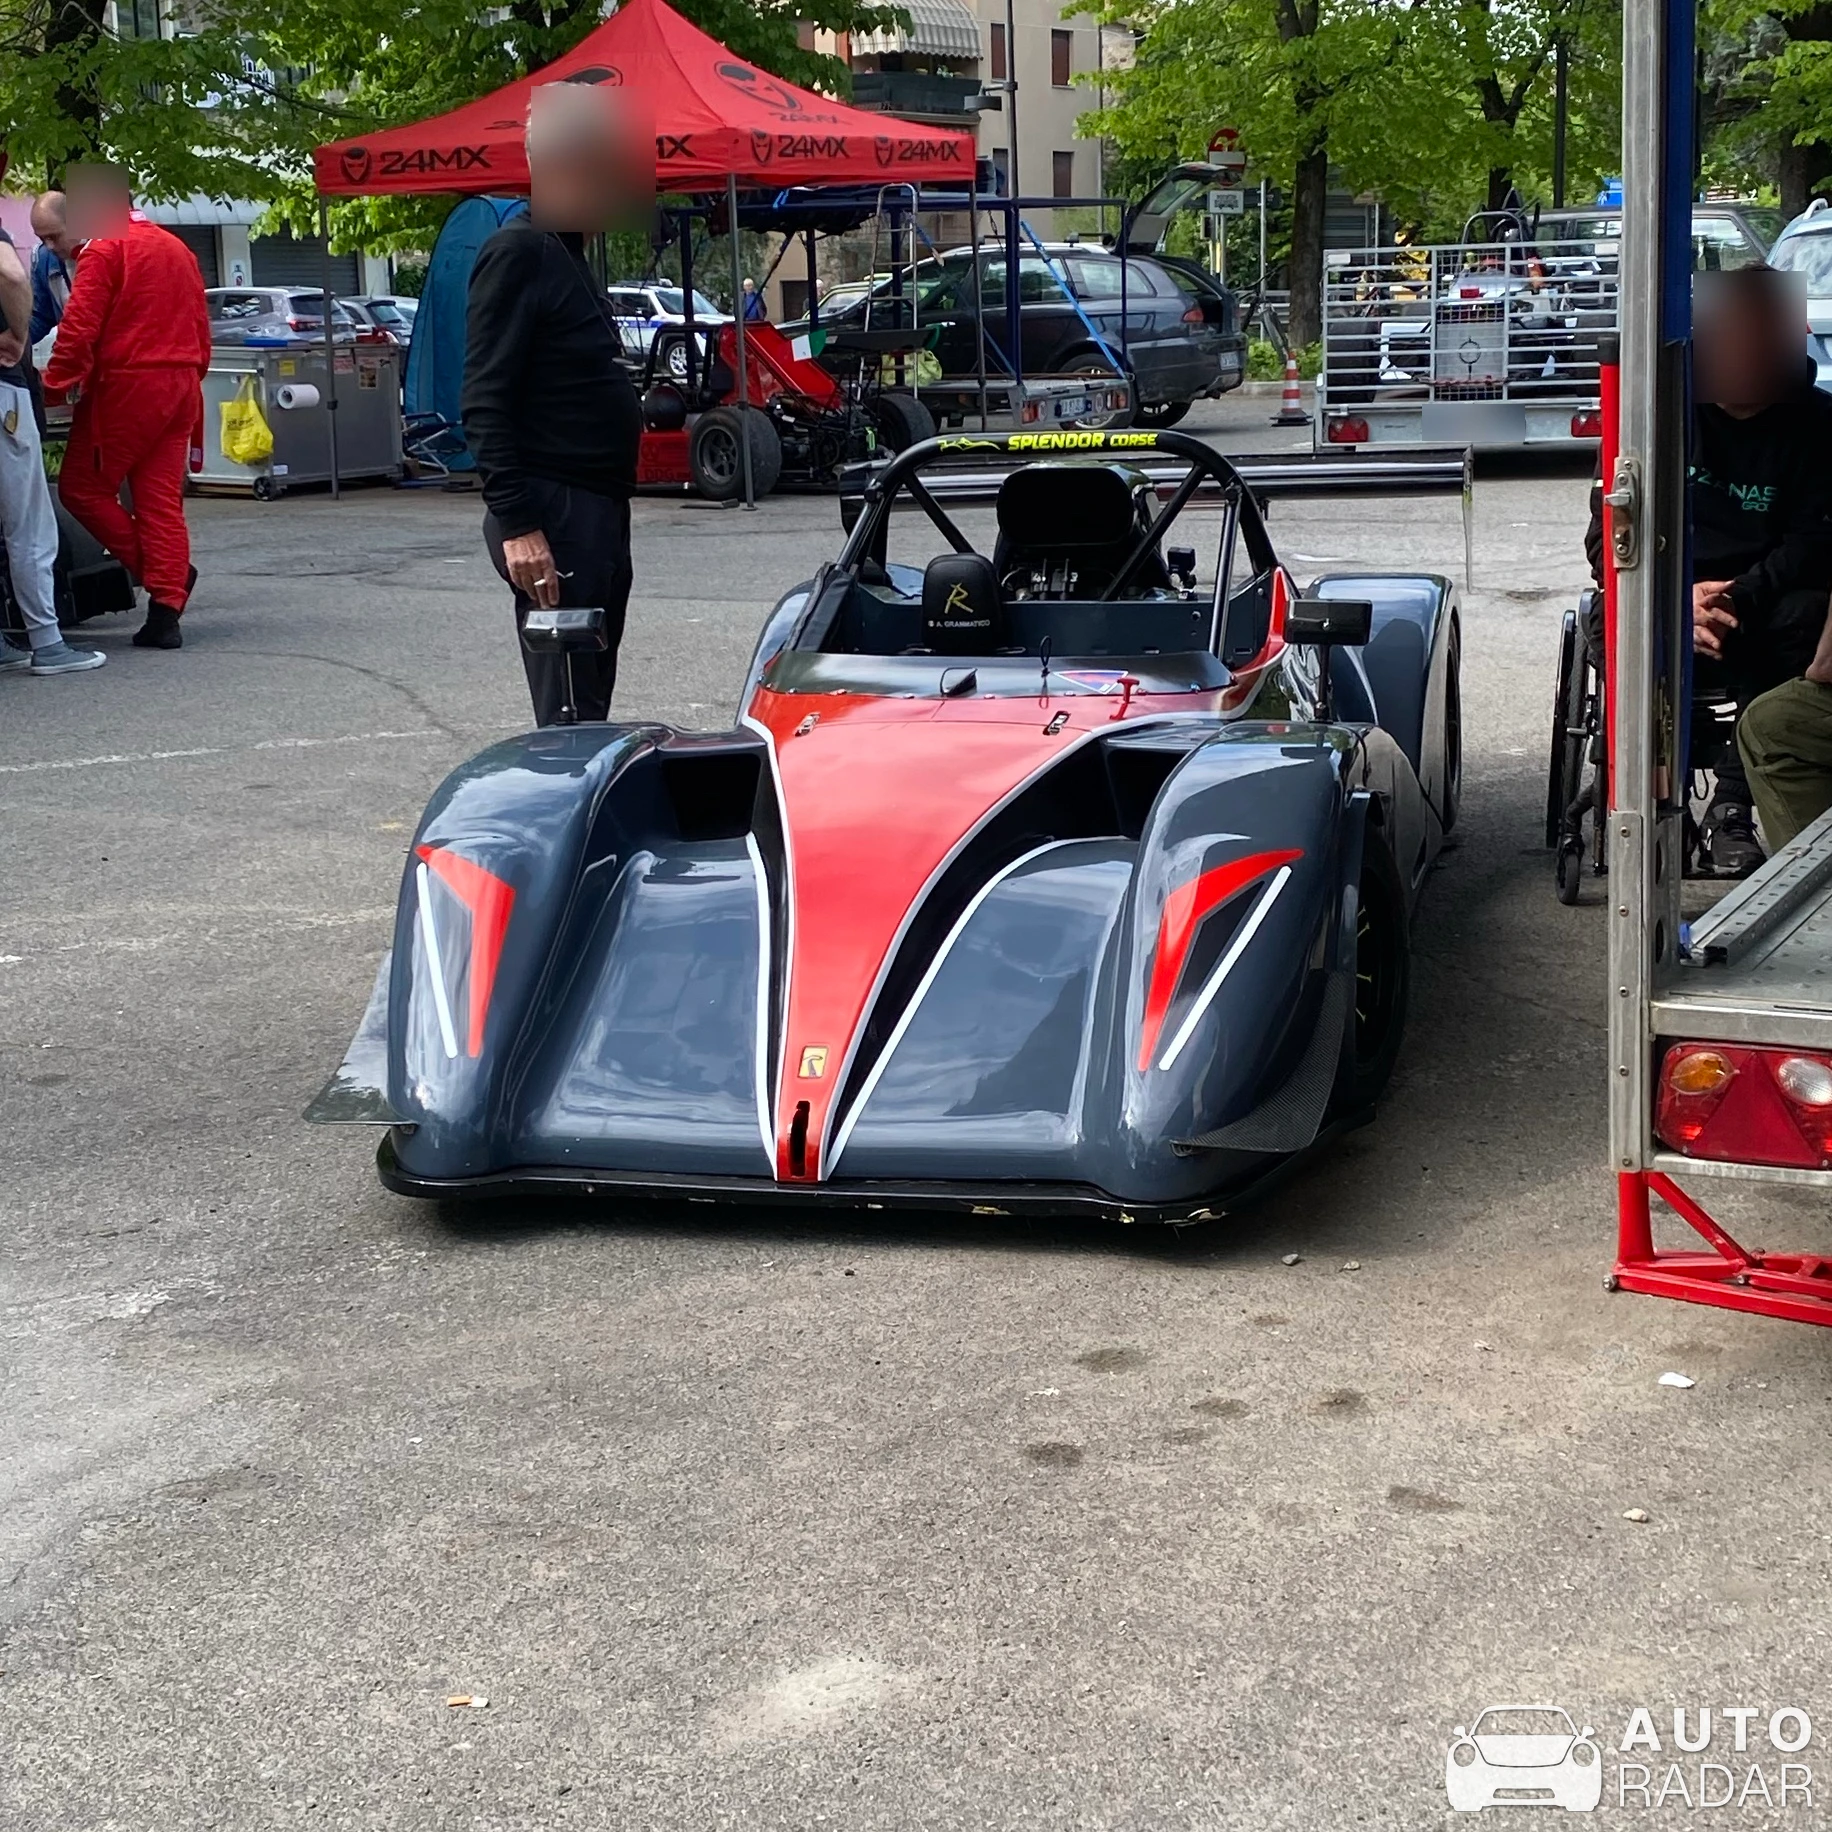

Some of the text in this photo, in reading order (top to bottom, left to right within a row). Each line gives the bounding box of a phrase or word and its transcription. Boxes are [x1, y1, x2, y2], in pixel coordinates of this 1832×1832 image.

[777, 135, 850, 159] 24MX
[897, 139, 961, 162] 24MX
[380, 145, 492, 174] 24MX
[1008, 433, 1158, 450] SPLENDOR CORSE
[944, 583, 974, 614] R
